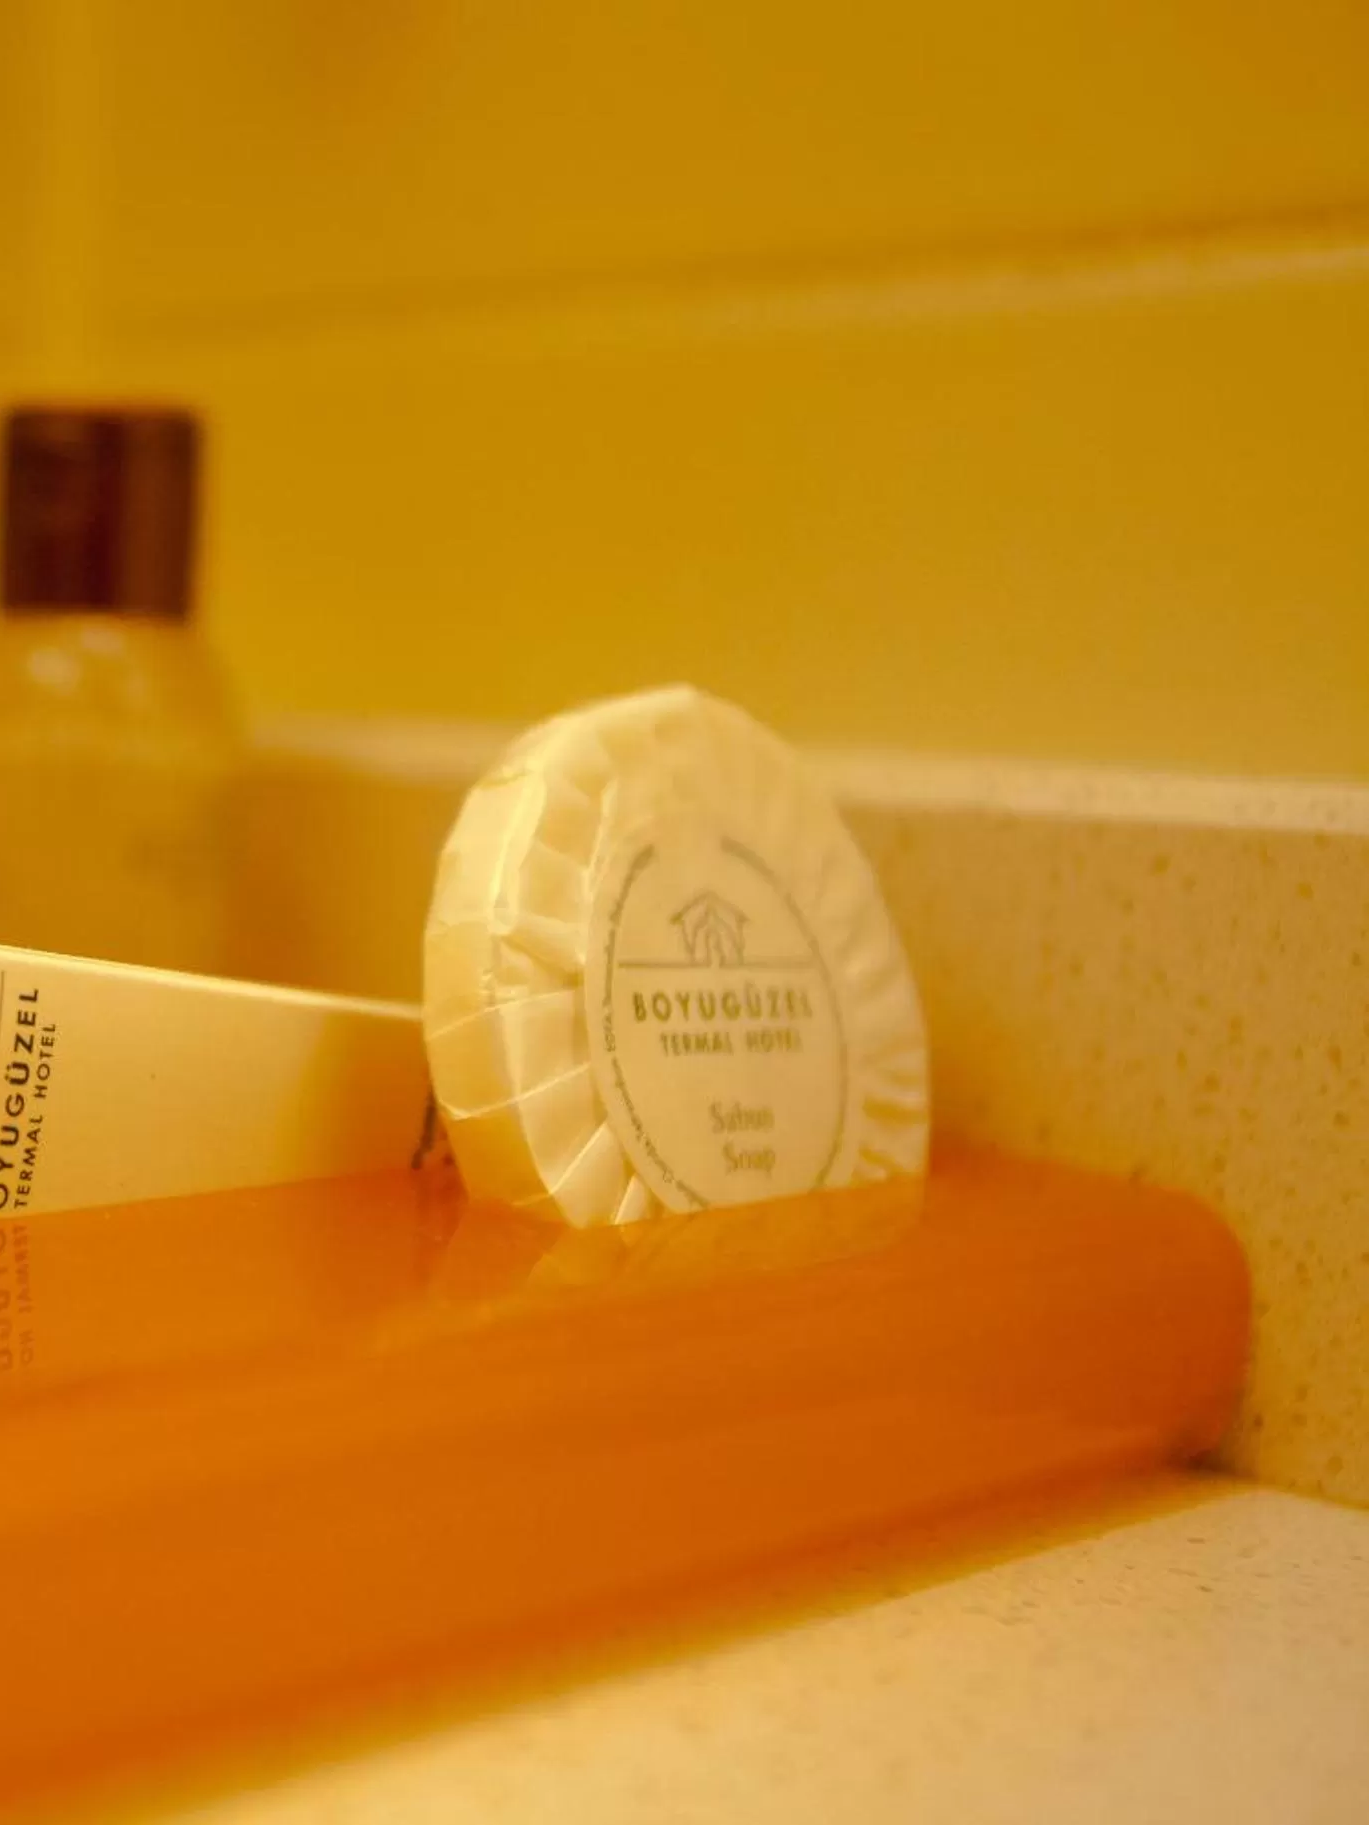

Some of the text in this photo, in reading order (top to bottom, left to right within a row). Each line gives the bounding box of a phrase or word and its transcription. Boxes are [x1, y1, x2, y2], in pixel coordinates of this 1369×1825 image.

[632, 979, 813, 1023] BOYUGÜZEL
[660, 1031, 734, 1058] TERMAL
[13, 1023, 57, 1210] TERMAL HOTEL
